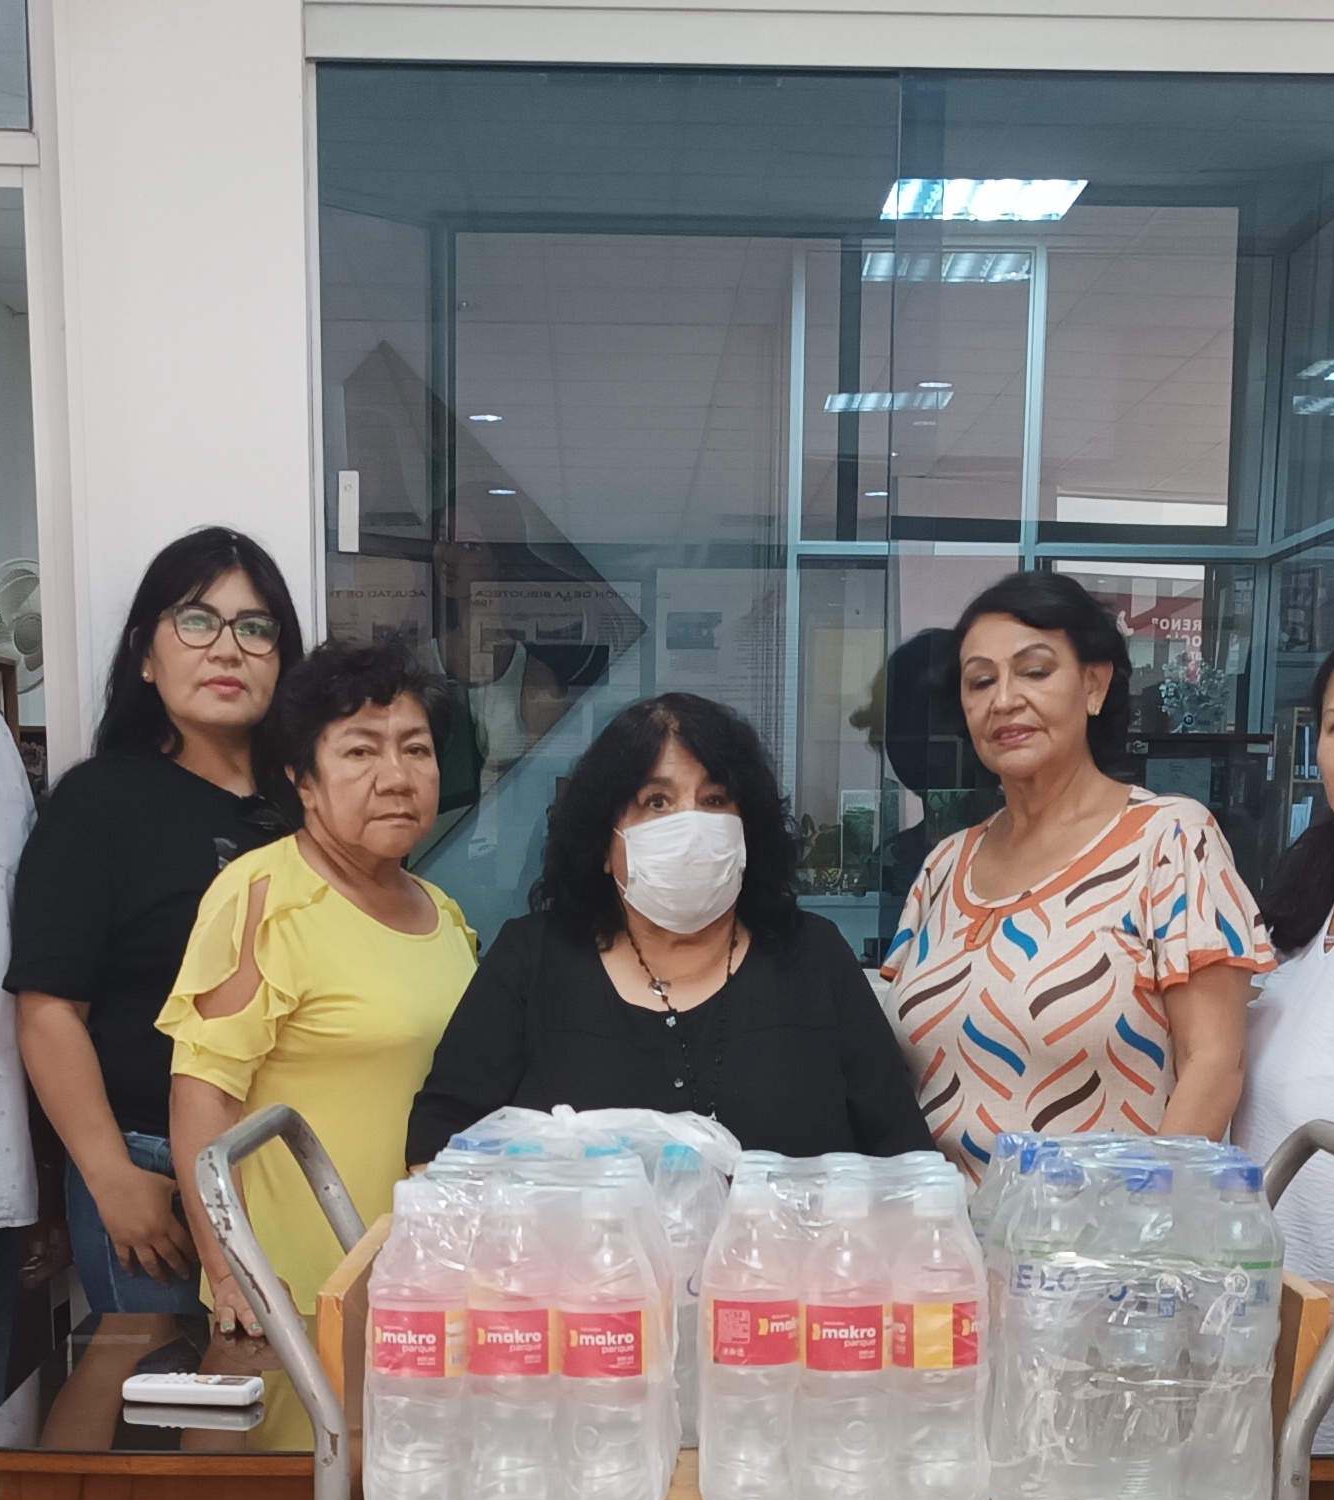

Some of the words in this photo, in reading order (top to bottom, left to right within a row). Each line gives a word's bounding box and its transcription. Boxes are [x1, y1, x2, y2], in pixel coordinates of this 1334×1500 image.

[770, 1317, 797, 1332] mak
[822, 1325, 876, 1339] makro
[383, 1330, 437, 1345] makro
[487, 1329, 542, 1344] makro
[579, 1331, 634, 1345] makro
